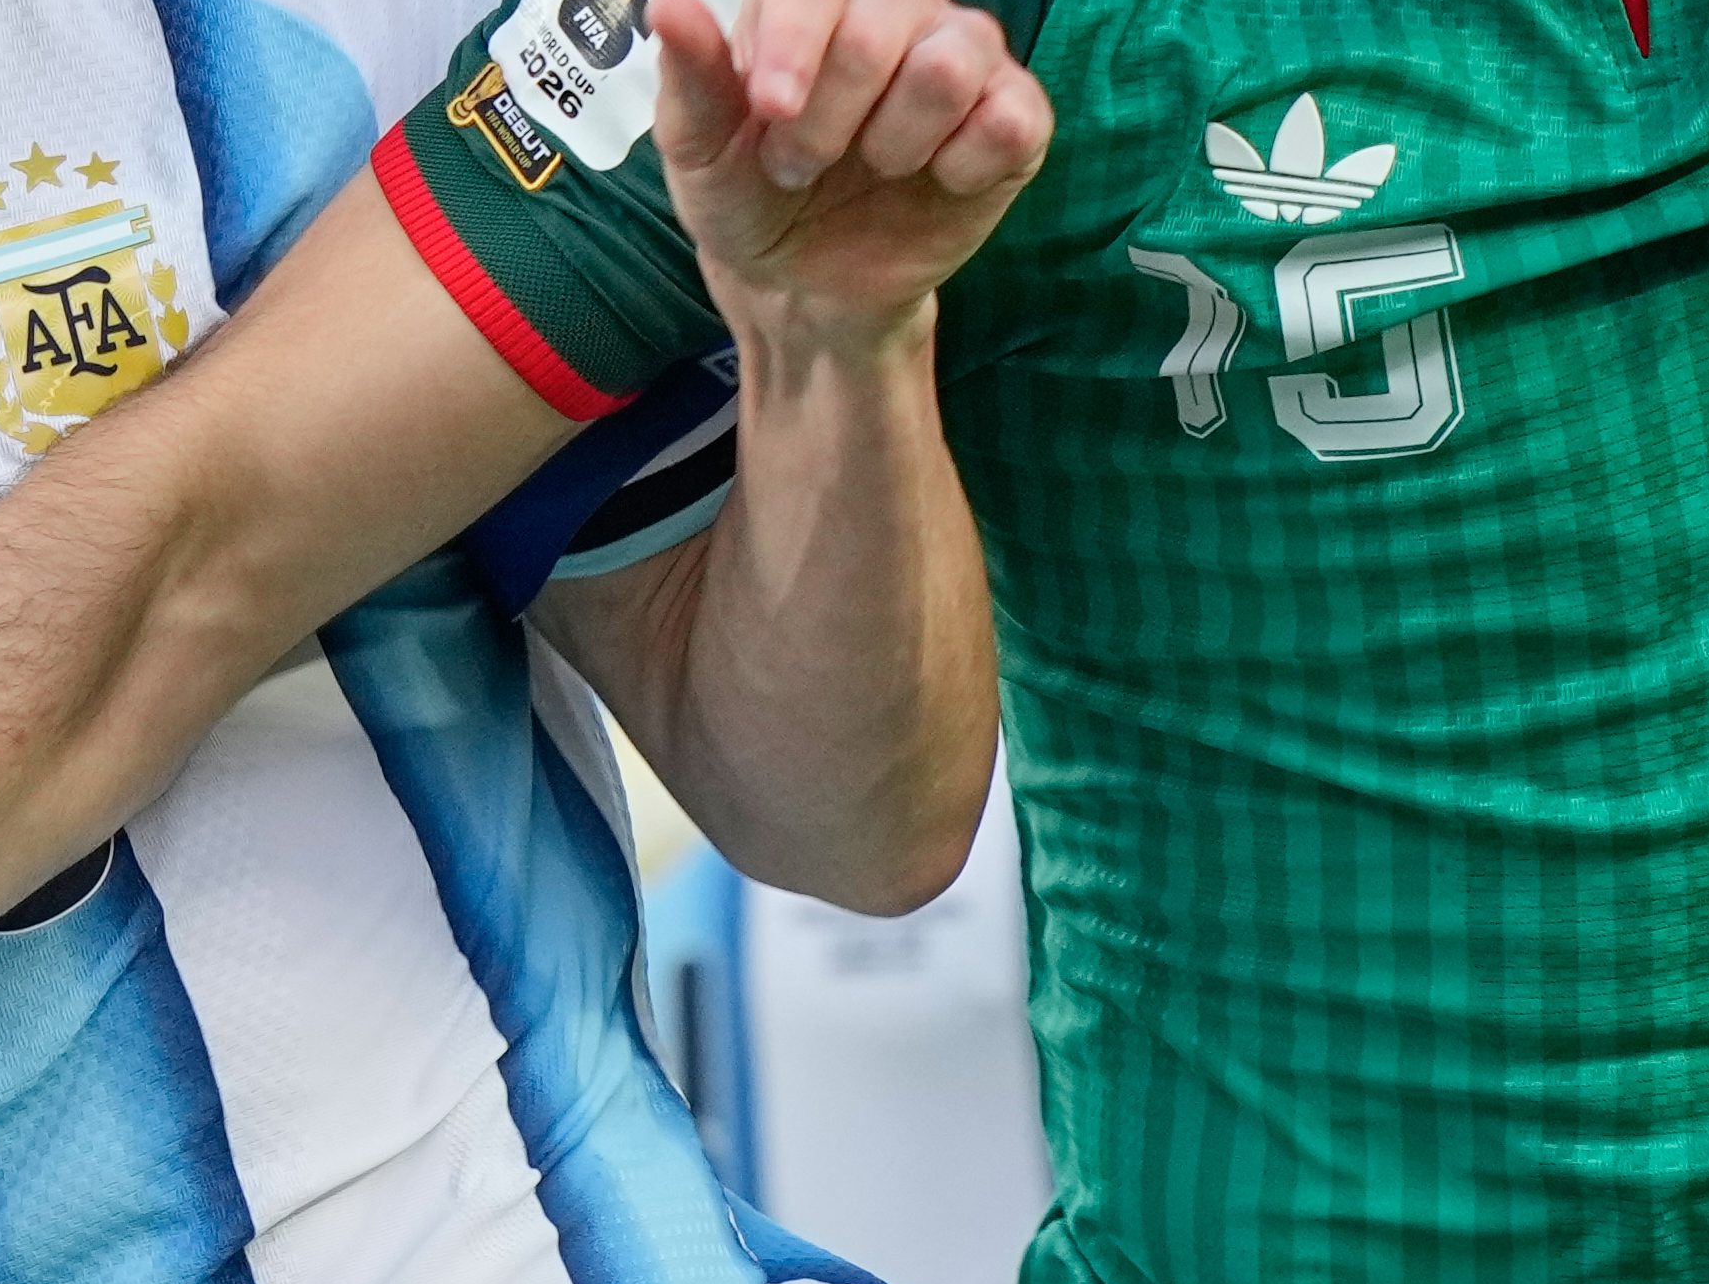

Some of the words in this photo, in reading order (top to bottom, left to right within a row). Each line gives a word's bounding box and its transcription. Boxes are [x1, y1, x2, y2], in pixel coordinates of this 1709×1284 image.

[572, 6, 609, 51] FIFA
[519, 39, 583, 119] 2026
[567, 66, 596, 96] CUP
[493, 92, 552, 161] DEBUT
[22, 265, 148, 378] AFA
[1128, 222, 1465, 463] 15
